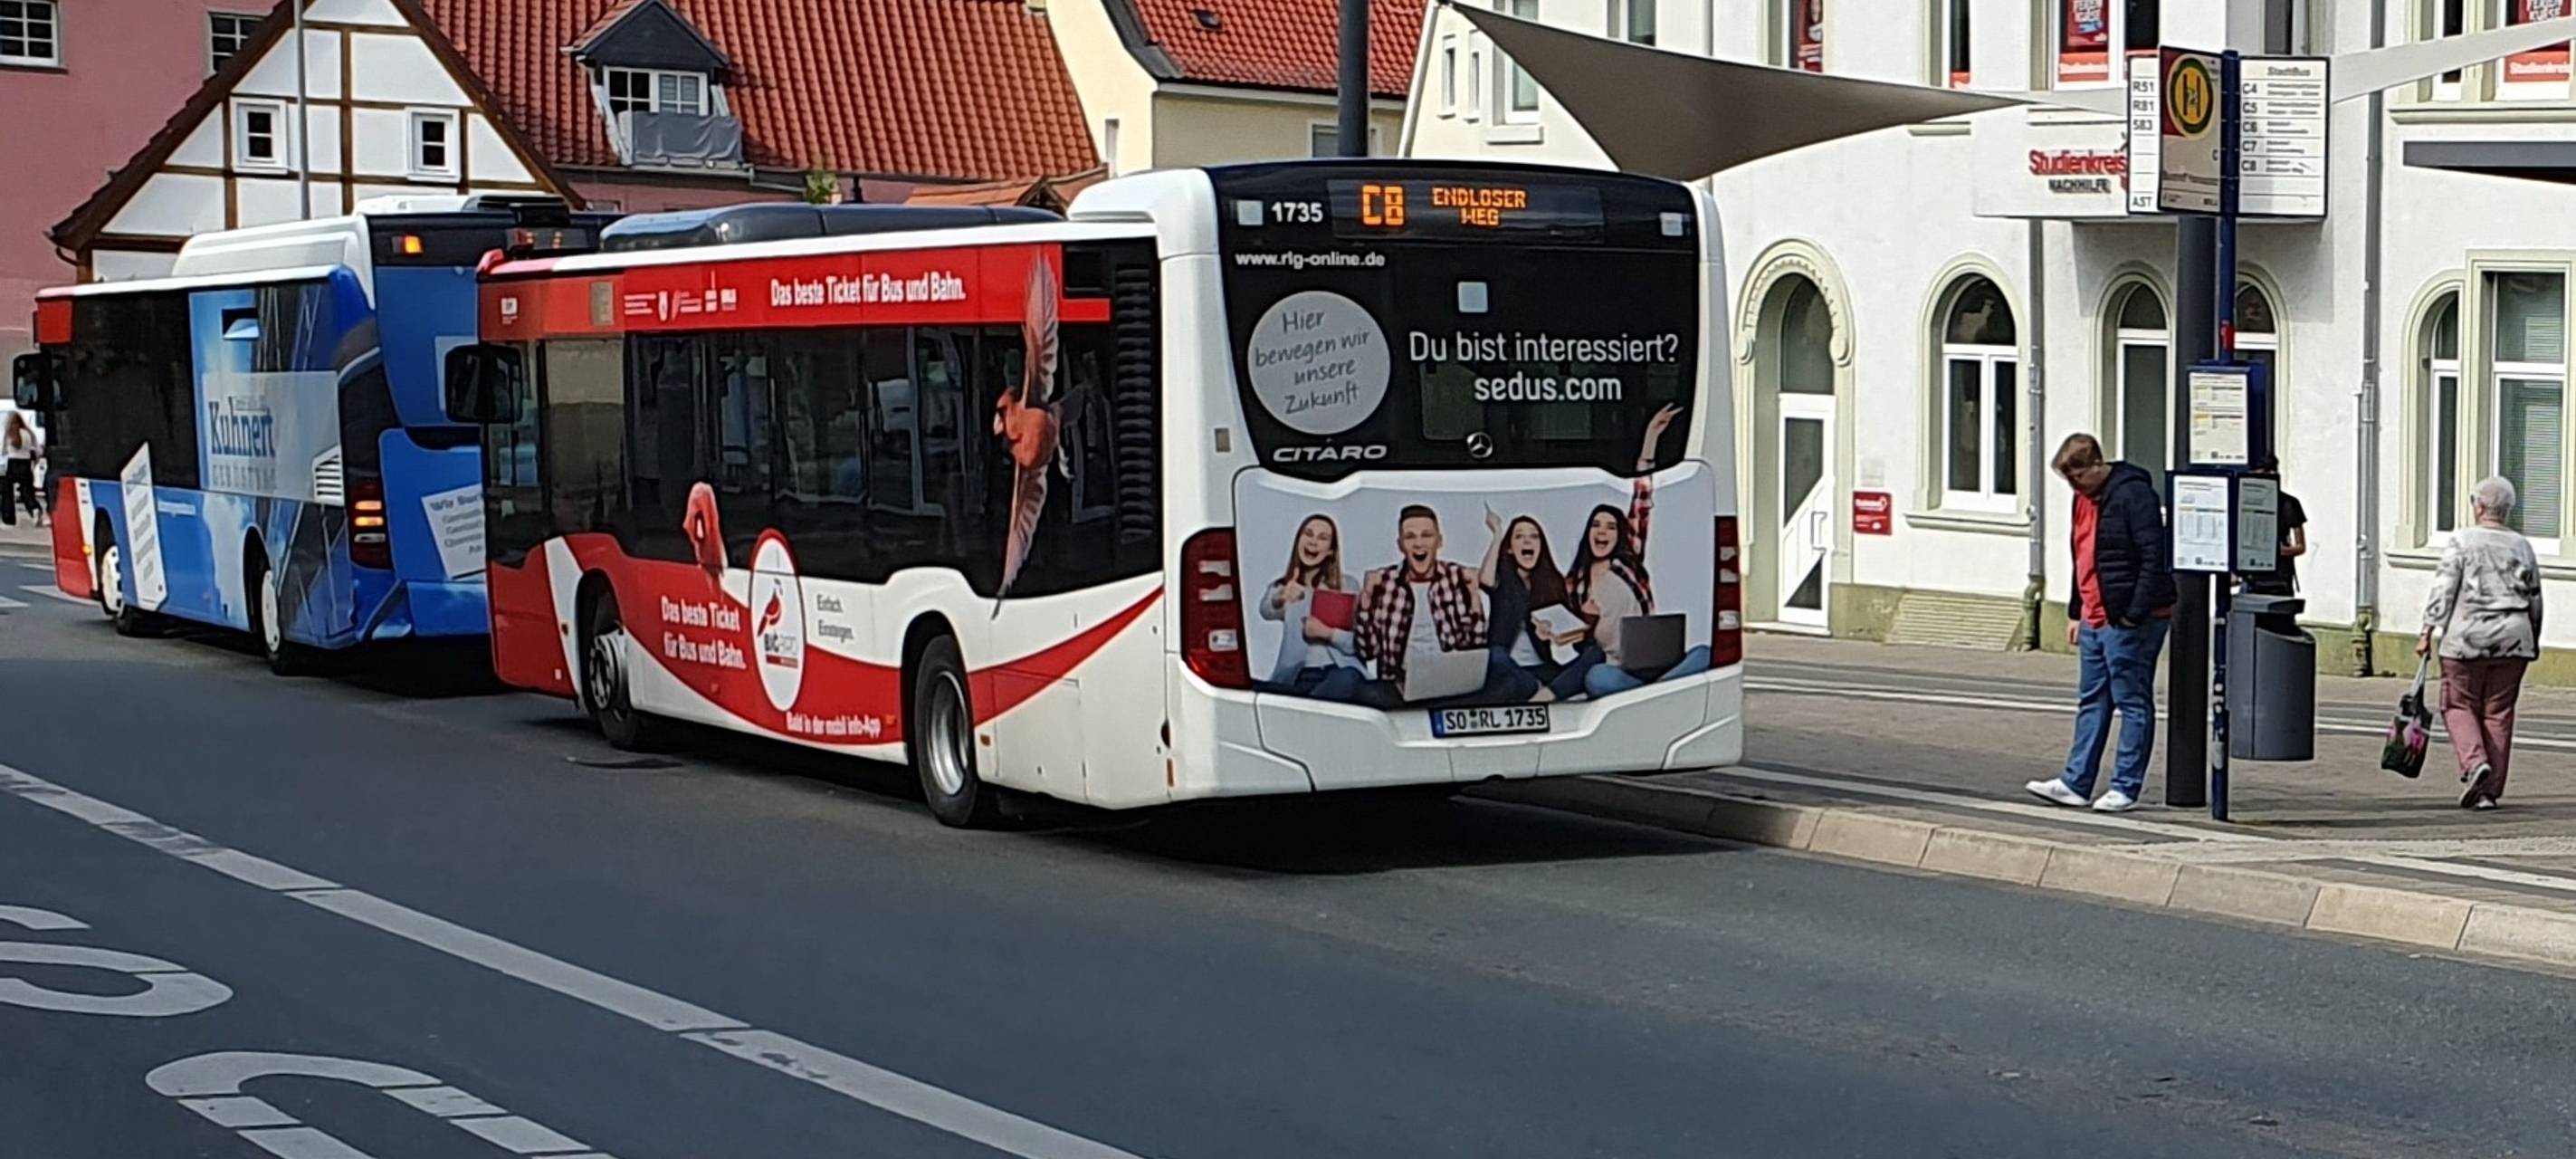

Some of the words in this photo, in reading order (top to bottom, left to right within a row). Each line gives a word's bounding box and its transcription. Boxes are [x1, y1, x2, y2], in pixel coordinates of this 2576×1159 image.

[2132, 81, 2155, 92] R51
[2242, 82, 2258, 94] C4
[2132, 100, 2155, 111] R81
[2242, 102, 2258, 113] C5
[2242, 140, 2257, 151] C7
[1362, 185, 1405, 225] C8
[1432, 187, 1527, 209] ENDLOSER
[2132, 196, 2153, 207] AST
[1272, 201, 1324, 223] 1735
[1461, 208, 1500, 225] WEG
[1236, 250, 1387, 270] www.rlg-online.de
[771, 278, 793, 306] Das
[794, 277, 825, 305] beste
[825, 274, 861, 304] Ticket
[880, 273, 904, 302] Bus
[906, 272, 929, 302] und
[1282, 311, 1325, 334] Hier
[1255, 338, 1337, 368] bewegen
[1340, 330, 1370, 350] wir
[1409, 330, 1447, 361] Du
[1455, 330, 1508, 361] bist
[1514, 331, 1679, 362] interessiert?
[1294, 359, 1357, 384] unsere
[1474, 370, 1622, 401] sedus.com
[1283, 380, 1360, 415] Zukunft
[1273, 445, 1388, 462] CITARO
[661, 594, 681, 623] Das
[681, 598, 708, 627] beste
[708, 601, 740, 632] Ticket
[678, 633, 697, 662] Bus
[698, 638, 716, 666] und
[1445, 711, 1466, 730] SO
[1479, 710, 1502, 728] RL
[1504, 708, 1546, 728] 1735
